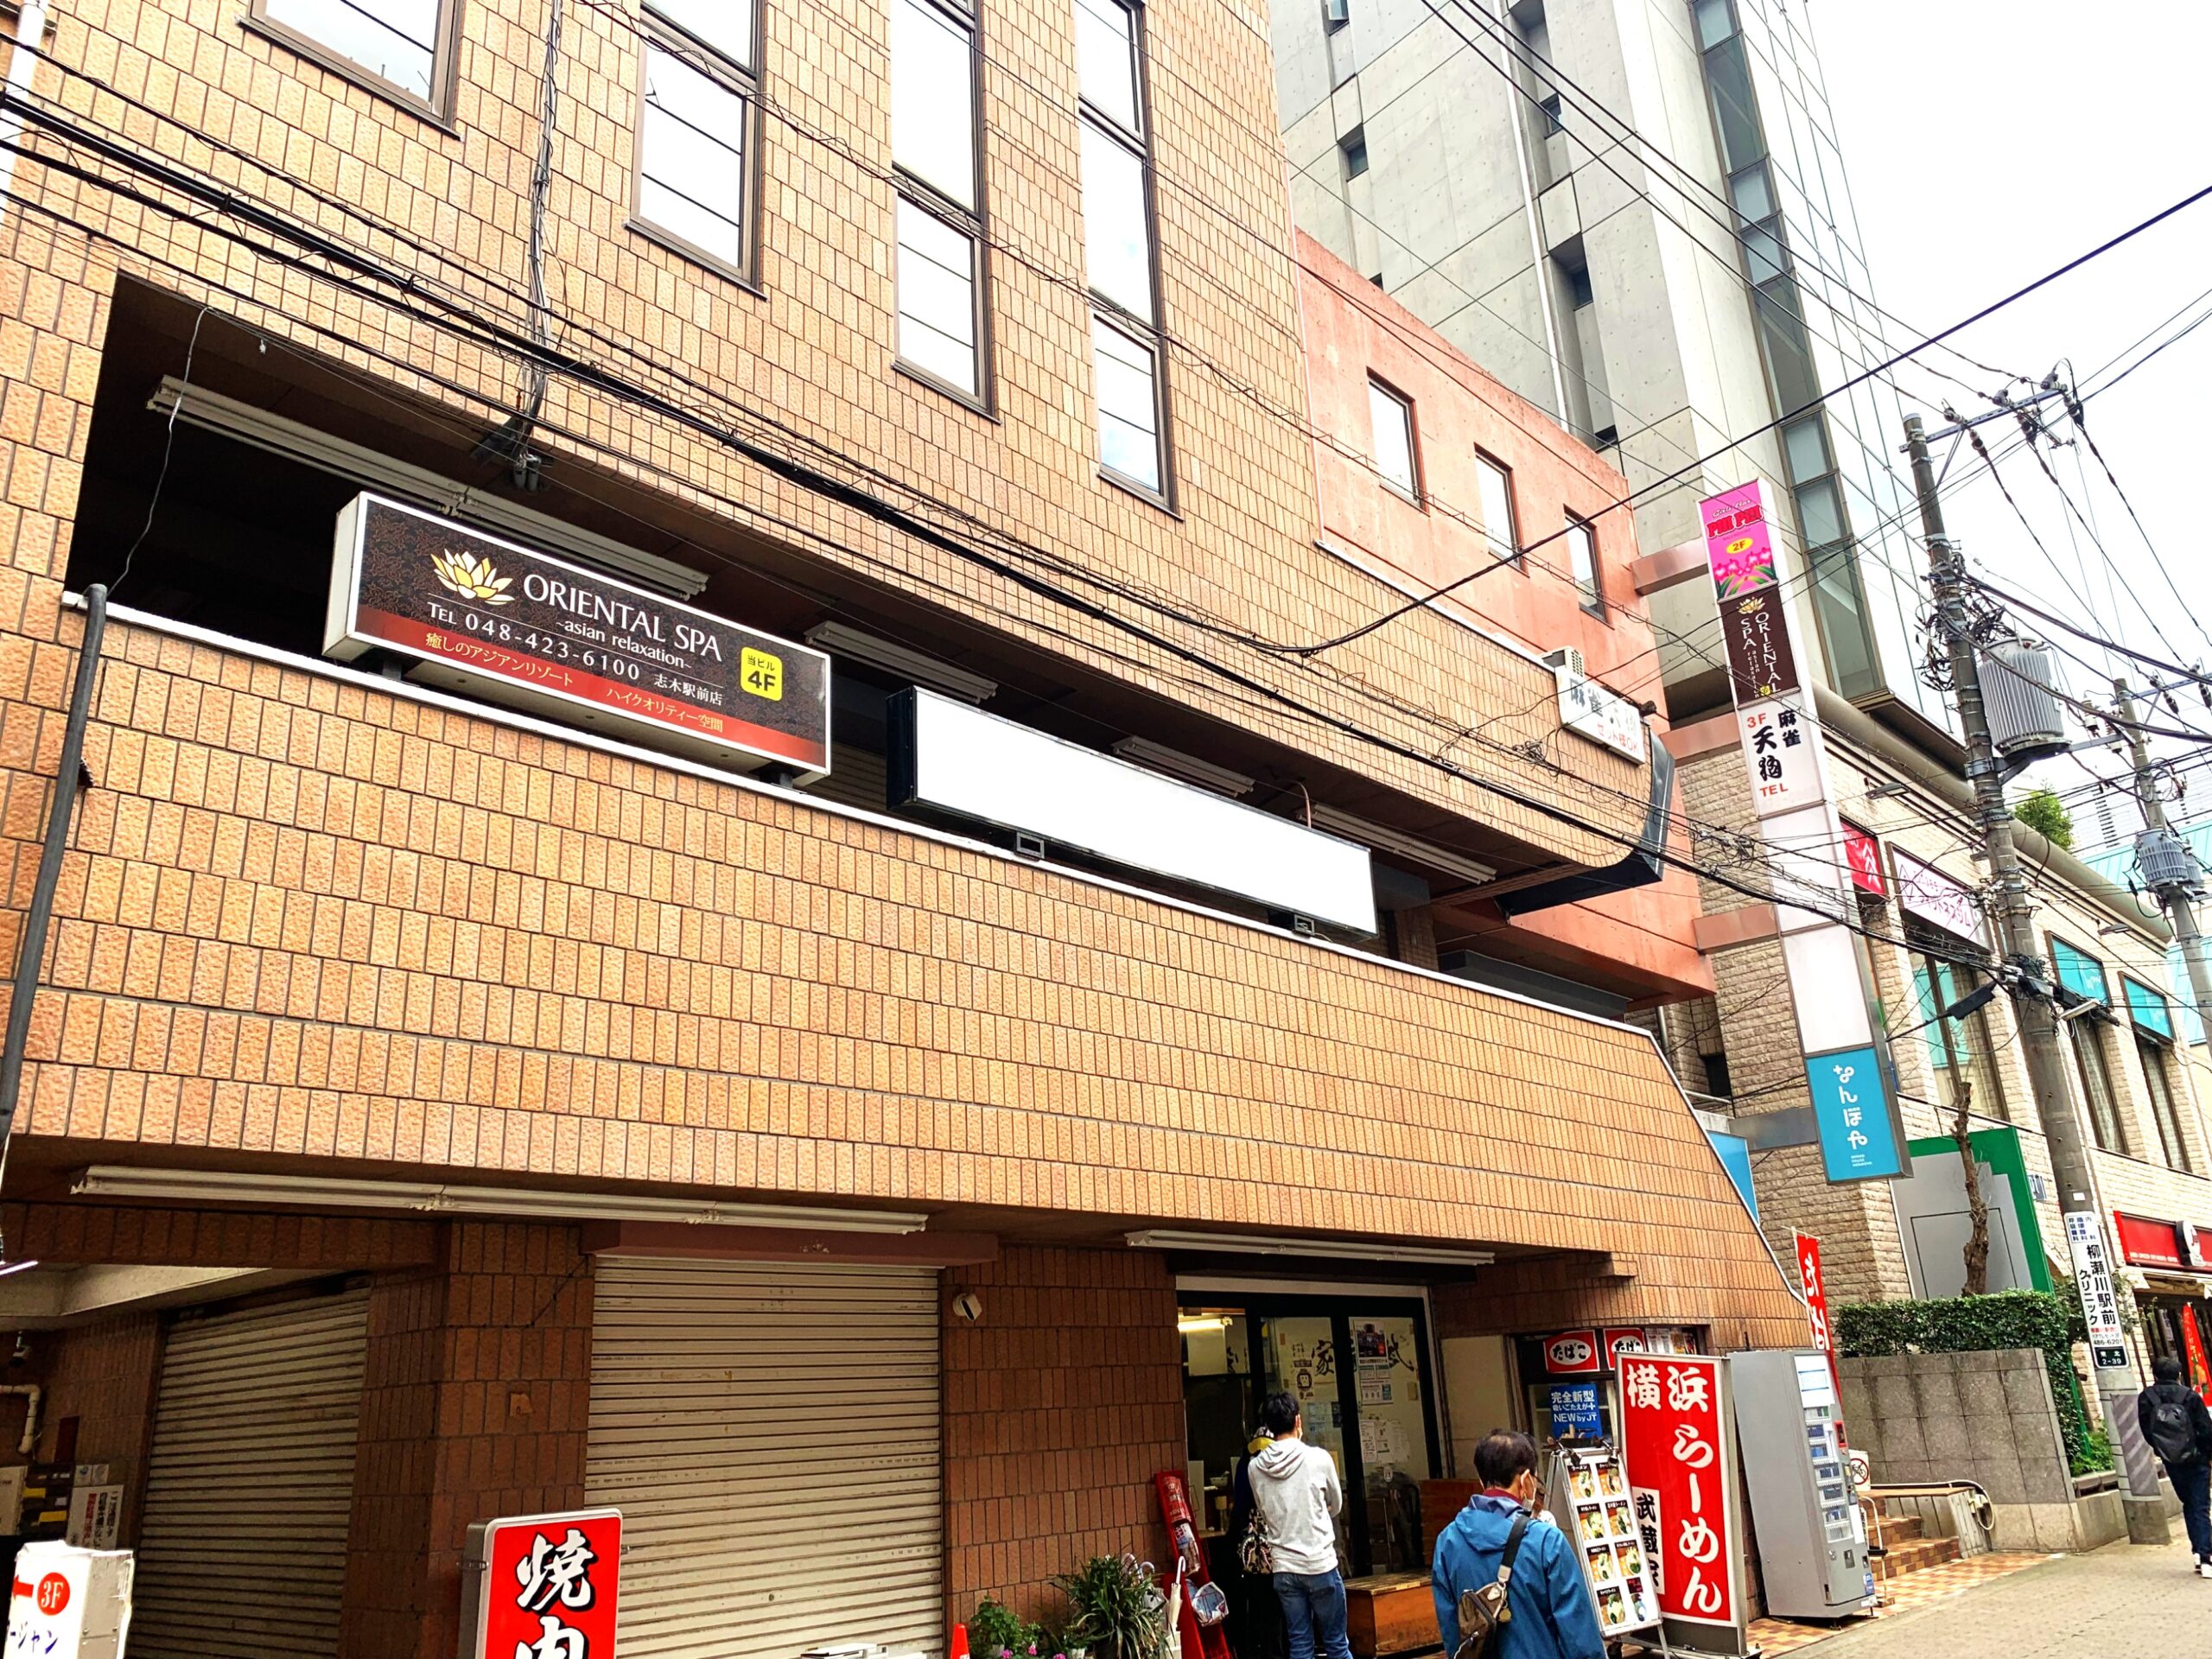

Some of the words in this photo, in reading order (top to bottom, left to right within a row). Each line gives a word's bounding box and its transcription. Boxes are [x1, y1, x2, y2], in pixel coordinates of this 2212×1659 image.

[1732, 539, 1745, 551] 2F
[523, 574, 665, 642] ORIENTAL
[673, 624, 722, 664] SPA
[1740, 618, 1757, 650] SPA
[425, 632, 574, 687] 癒しのアジアンリゾート
[427, 602, 457, 625] TEL
[465, 613, 640, 681] 048-423-6100
[1755, 612, 1781, 693] ORIENTAL
[747, 654, 775, 672] 当ビル
[747, 671, 776, 691] 4F
[654, 673, 722, 706] 志木駅前店
[607, 689, 723, 733] ハイクオリティー空間
[1746, 713, 1767, 728] 3F
[1777, 709, 1802, 748] 麻雀
[1759, 783, 1789, 798] TEL
[1833, 1065, 1868, 1150] なんぼや
[2079, 1268, 2099, 1325] クリニック
[2086, 1244, 2116, 1325] 柳瀬川駅前
[1553, 1343, 1586, 1361] たばこ
[1551, 1389, 1596, 1404] 完全新型
[1673, 1424, 1722, 1613] らーめん
[41, 1580, 64, 1610] 3F
